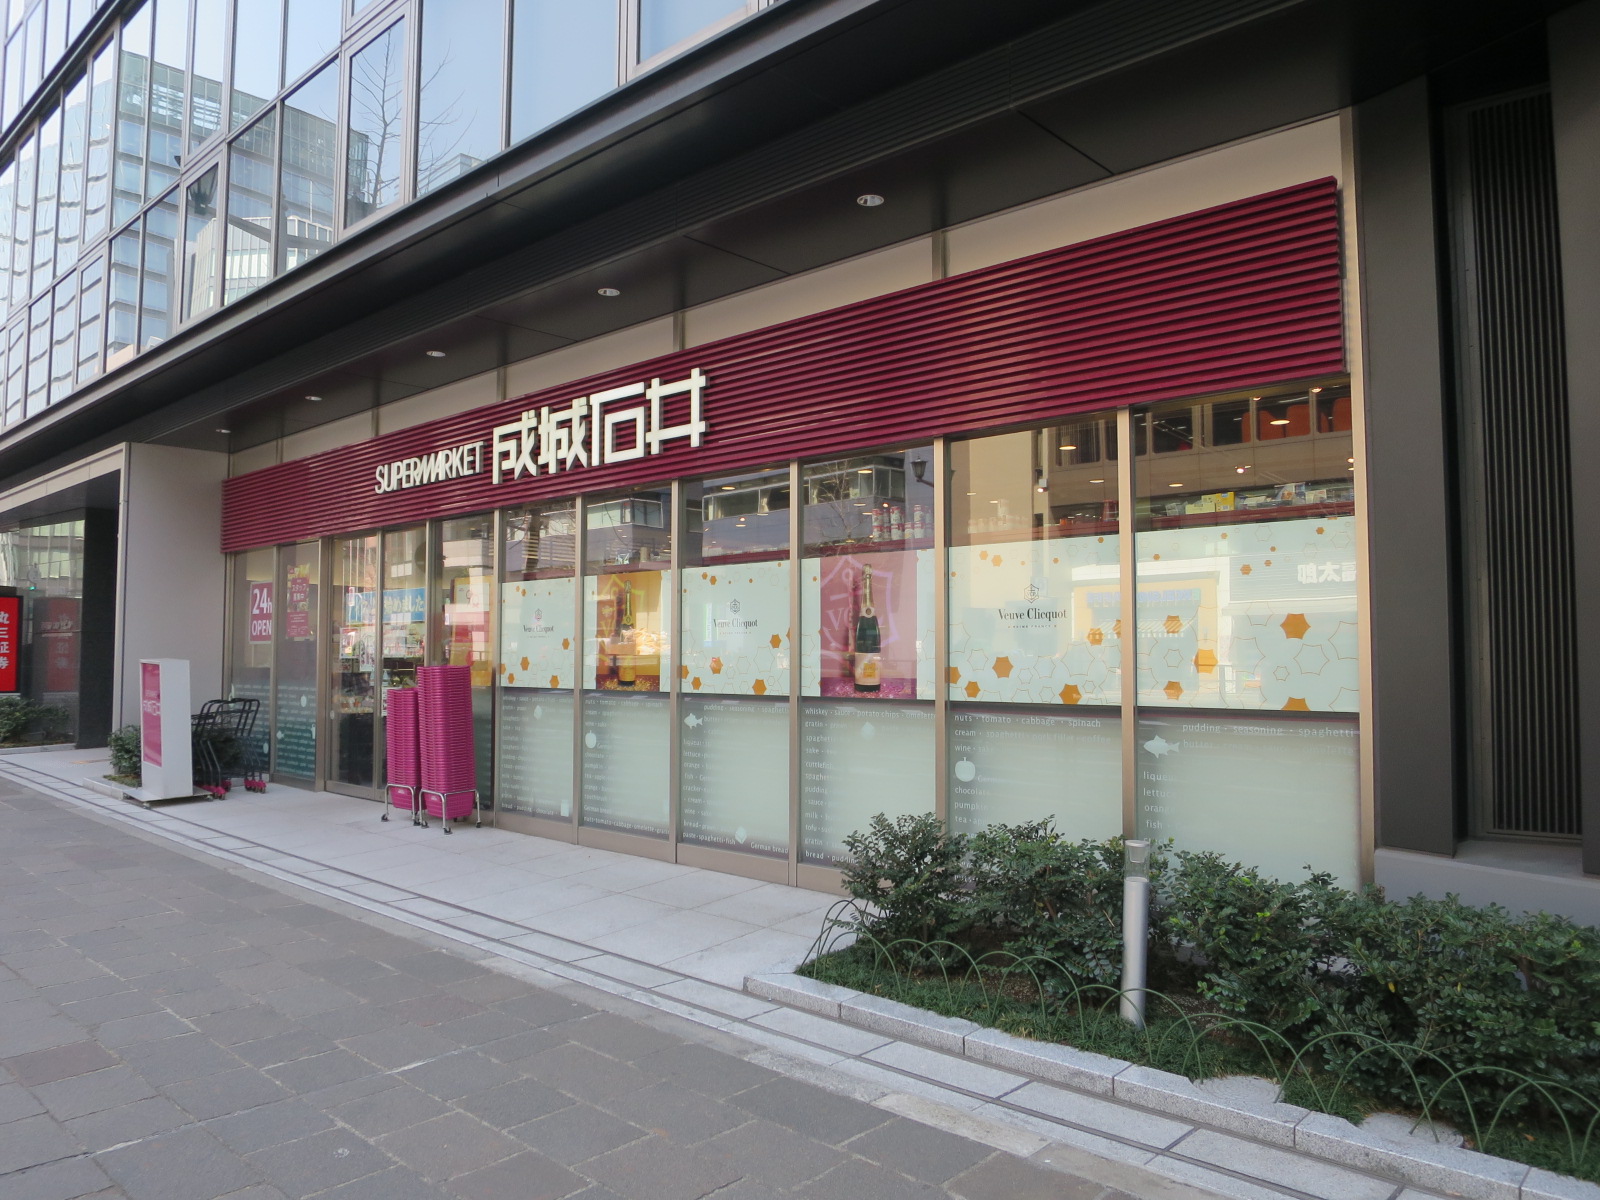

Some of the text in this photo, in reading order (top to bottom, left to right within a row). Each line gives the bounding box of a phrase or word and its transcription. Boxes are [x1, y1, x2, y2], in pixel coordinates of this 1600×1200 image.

[375, 376, 706, 493] SUPERMARKET 成城石井
[251, 587, 272, 615] 24h
[998, 607, 1068, 622] Veuve Clicquot
[251, 619, 272, 636] OPEN
[713, 618, 758, 629] Veuve Clicquot
[804, 708, 828, 717] whiskey
[857, 710, 880, 718] potato
[880, 710, 900, 719] chips
[804, 720, 823, 728] gratin
[954, 714, 1101, 728] nuts tomato cabbage spinach
[954, 729, 976, 737] cream
[1182, 722, 1354, 738] pudding seasoning spaghetti
[954, 744, 971, 752] wine
[1142, 771, 1175, 782] liqueu
[807, 798, 823, 806] sauce
[804, 811, 818, 819] milk
[954, 815, 967, 823] tea
[683, 819, 699, 828] bread
[1146, 819, 1163, 830] fish
[698, 834, 724, 843] spaghetti
[750, 842, 771, 851] German
[805, 851, 858, 864] bread puddin
